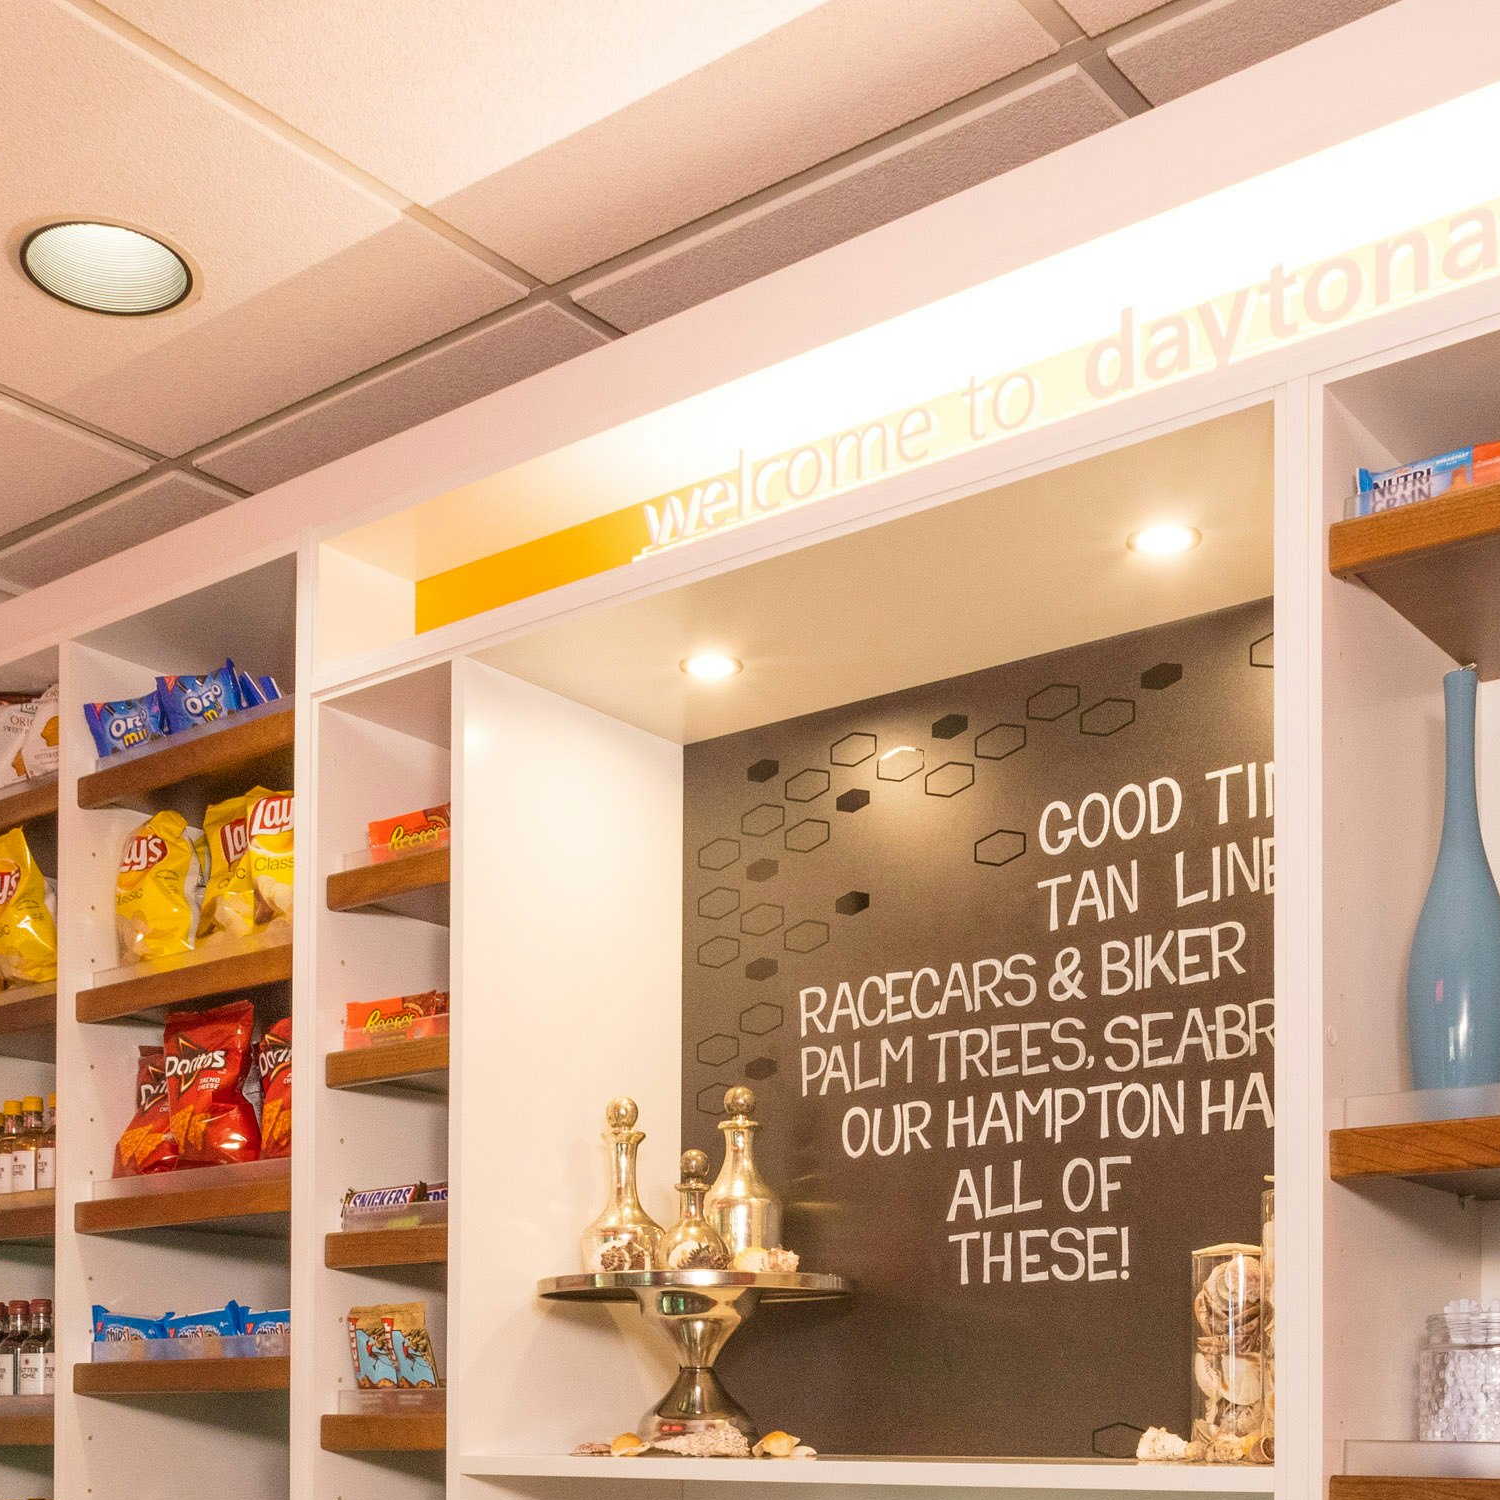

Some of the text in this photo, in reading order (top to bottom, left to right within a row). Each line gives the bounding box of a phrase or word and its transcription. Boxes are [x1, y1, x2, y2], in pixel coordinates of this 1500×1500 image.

[643, 407, 933, 548] welcome
[960, 370, 1037, 442] to
[1083, 207, 1499, 402] daytona
[1039, 777, 1182, 855] GOOD
[1037, 859, 1138, 932] TAN
[800, 921, 1246, 1038] RACECARS & BIKER
[166, 1051, 226, 1077] Doritos
[802, 1034, 913, 1097] PALM
[928, 1017, 1095, 1086] TREES,
[842, 1101, 932, 1160] OUR
[946, 1080, 1185, 1149] HAMPTON
[352, 1188, 412, 1208] SNICKERS
[946, 1154, 1132, 1223] ALL OF
[948, 1226, 1130, 1286] THESE!
